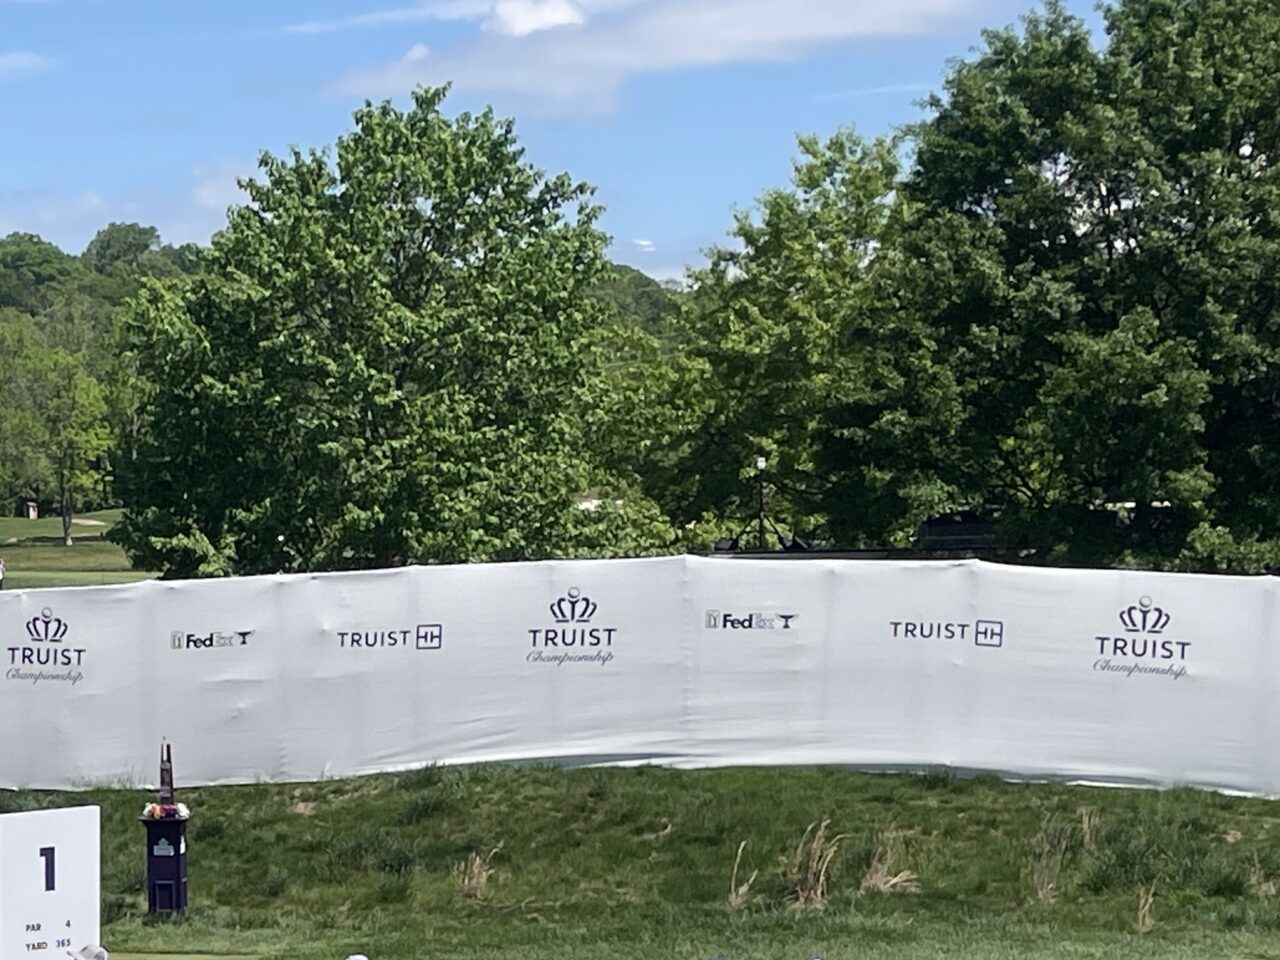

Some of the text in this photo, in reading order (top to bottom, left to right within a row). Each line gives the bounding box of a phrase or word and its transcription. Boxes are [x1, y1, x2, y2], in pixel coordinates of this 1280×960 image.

[722, 613, 775, 629] FedEx
[889, 621, 970, 640] TRUIST
[186, 631, 234, 649] FedEx
[337, 630, 412, 648] TRUIST
[527, 628, 618, 648] TRUIST
[7, 646, 87, 666] TRUIST
[1094, 636, 1192, 660] TRUIST
[526, 649, 614, 667] Championship
[5, 667, 84, 686] Championship
[1092, 658, 1188, 681] Championship
[39, 846, 56, 892] 1
[25, 923, 42, 932] PAR
[25, 941, 48, 952] YARD
